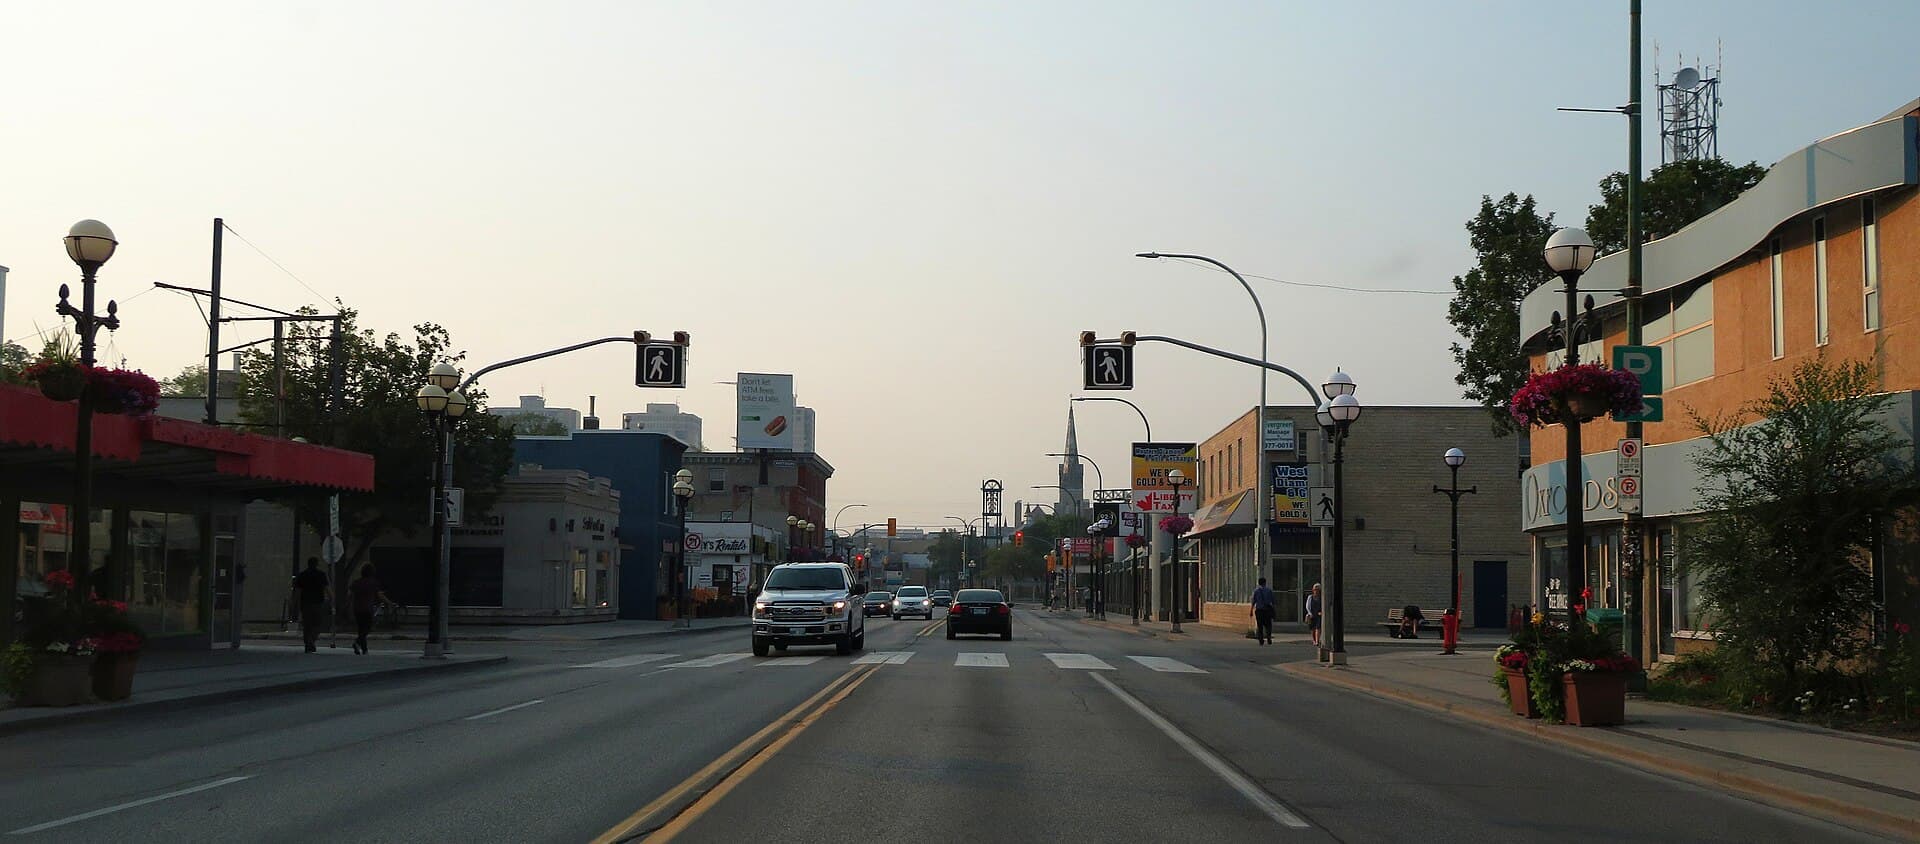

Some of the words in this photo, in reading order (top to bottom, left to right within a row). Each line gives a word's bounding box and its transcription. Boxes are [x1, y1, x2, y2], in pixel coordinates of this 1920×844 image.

[1623, 353, 1652, 374] P
[1151, 469, 1163, 477] WE
[1136, 478, 1157, 486] GOLD
[1167, 477, 1193, 487] SER
[1153, 492, 1193, 501] LIBETY
[1153, 502, 1174, 510] TAX
[1280, 510, 1300, 518] GOLD
[715, 539, 747, 552] Rentals
